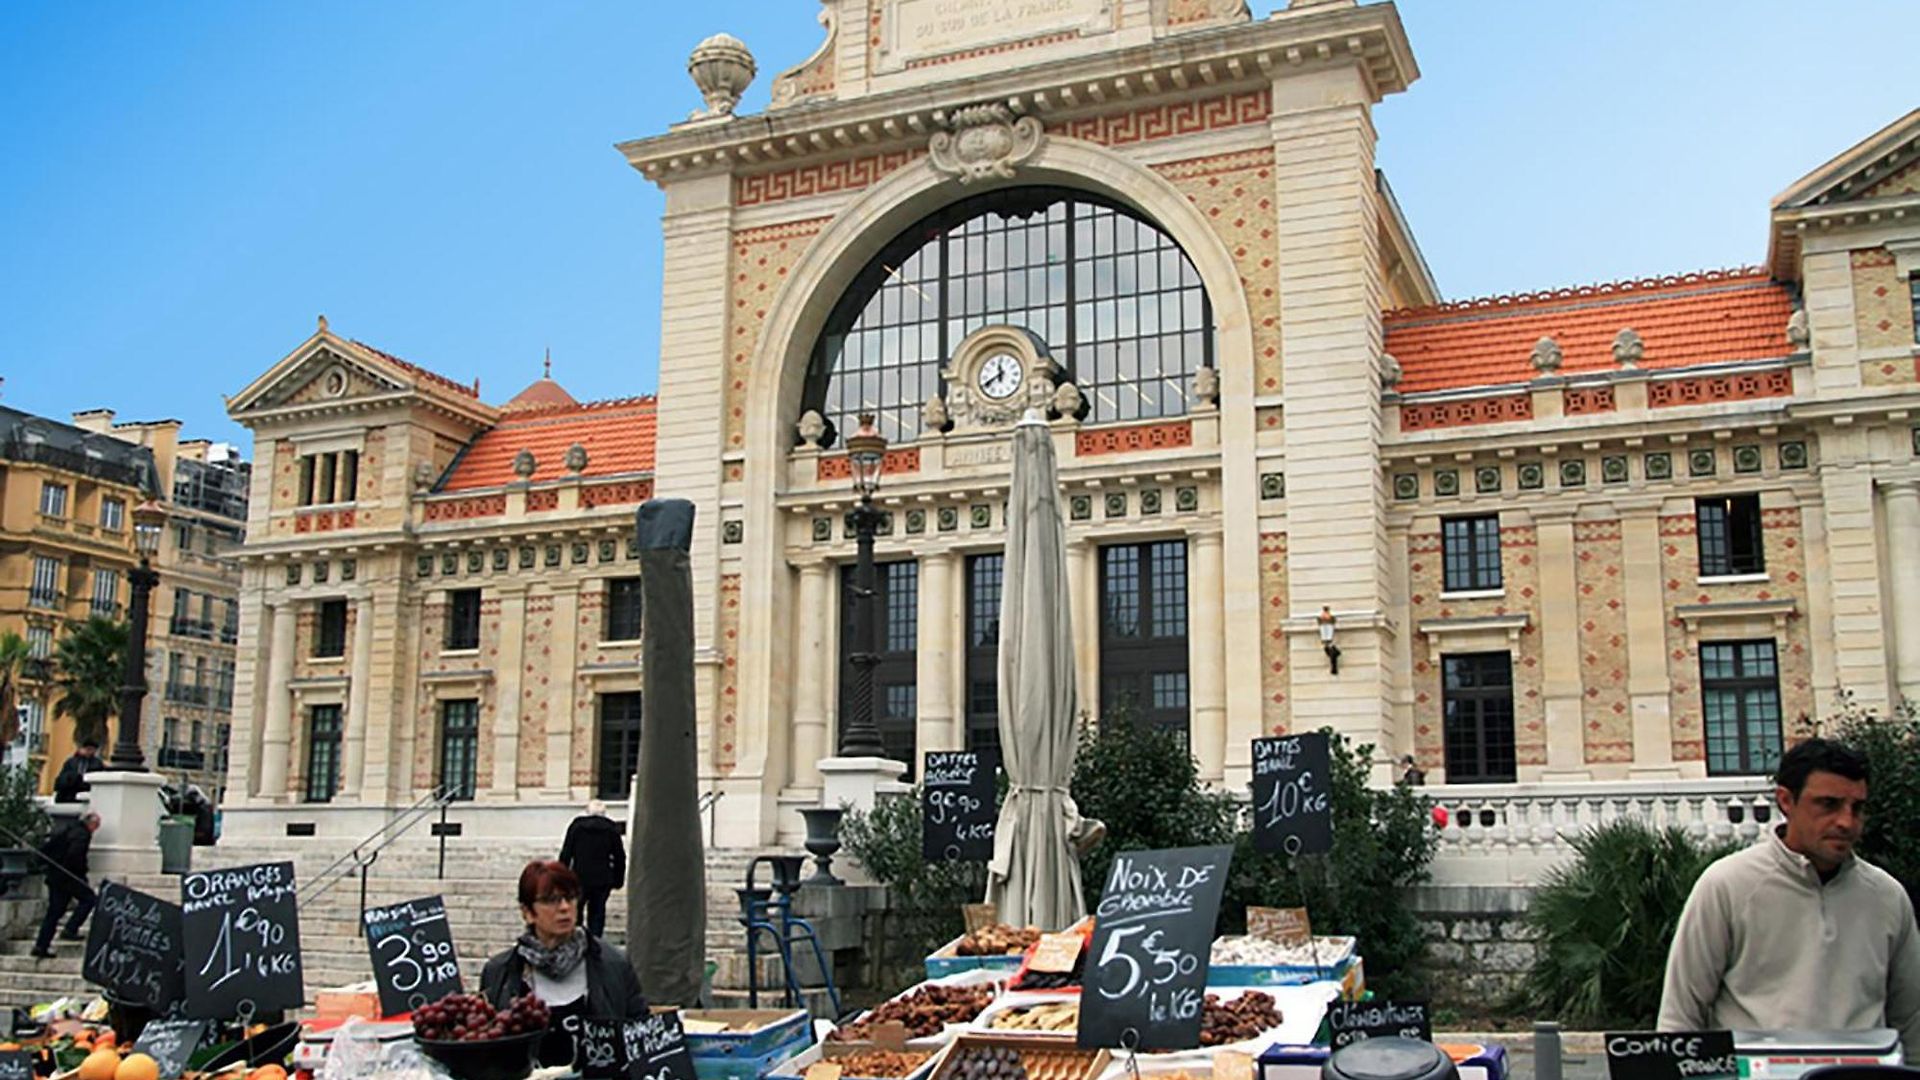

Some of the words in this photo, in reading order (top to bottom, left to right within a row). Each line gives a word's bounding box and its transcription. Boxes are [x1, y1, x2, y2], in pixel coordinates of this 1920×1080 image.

[1302, 792, 1327, 814] KG
[184, 866, 282, 899] ORANGES
[1176, 864, 1216, 889] DE
[271, 954, 296, 974] KG
